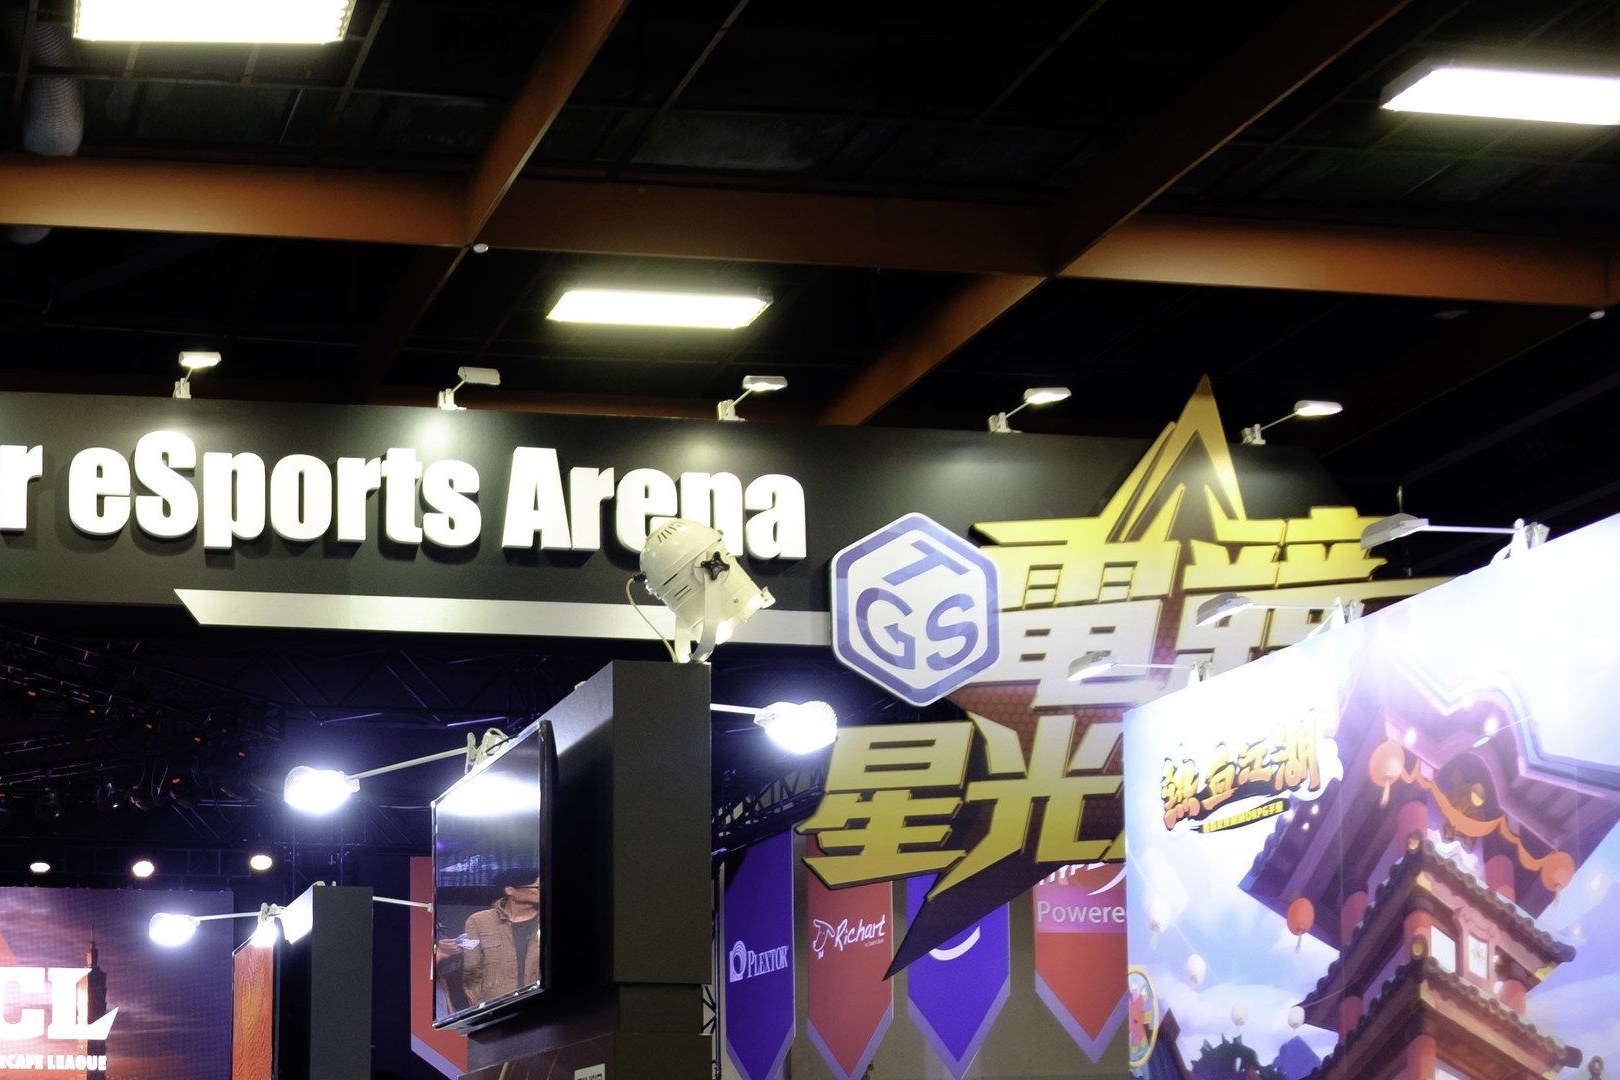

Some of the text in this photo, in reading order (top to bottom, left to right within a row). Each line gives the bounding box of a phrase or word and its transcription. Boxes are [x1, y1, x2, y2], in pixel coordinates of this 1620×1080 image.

[68, 430, 481, 549] eSports
[502, 446, 806, 560] Arena
[834, 915, 886, 951] Richart
[747, 946, 789, 978] PLEXTOR
[47, 1055, 107, 1071] LEAGUE
